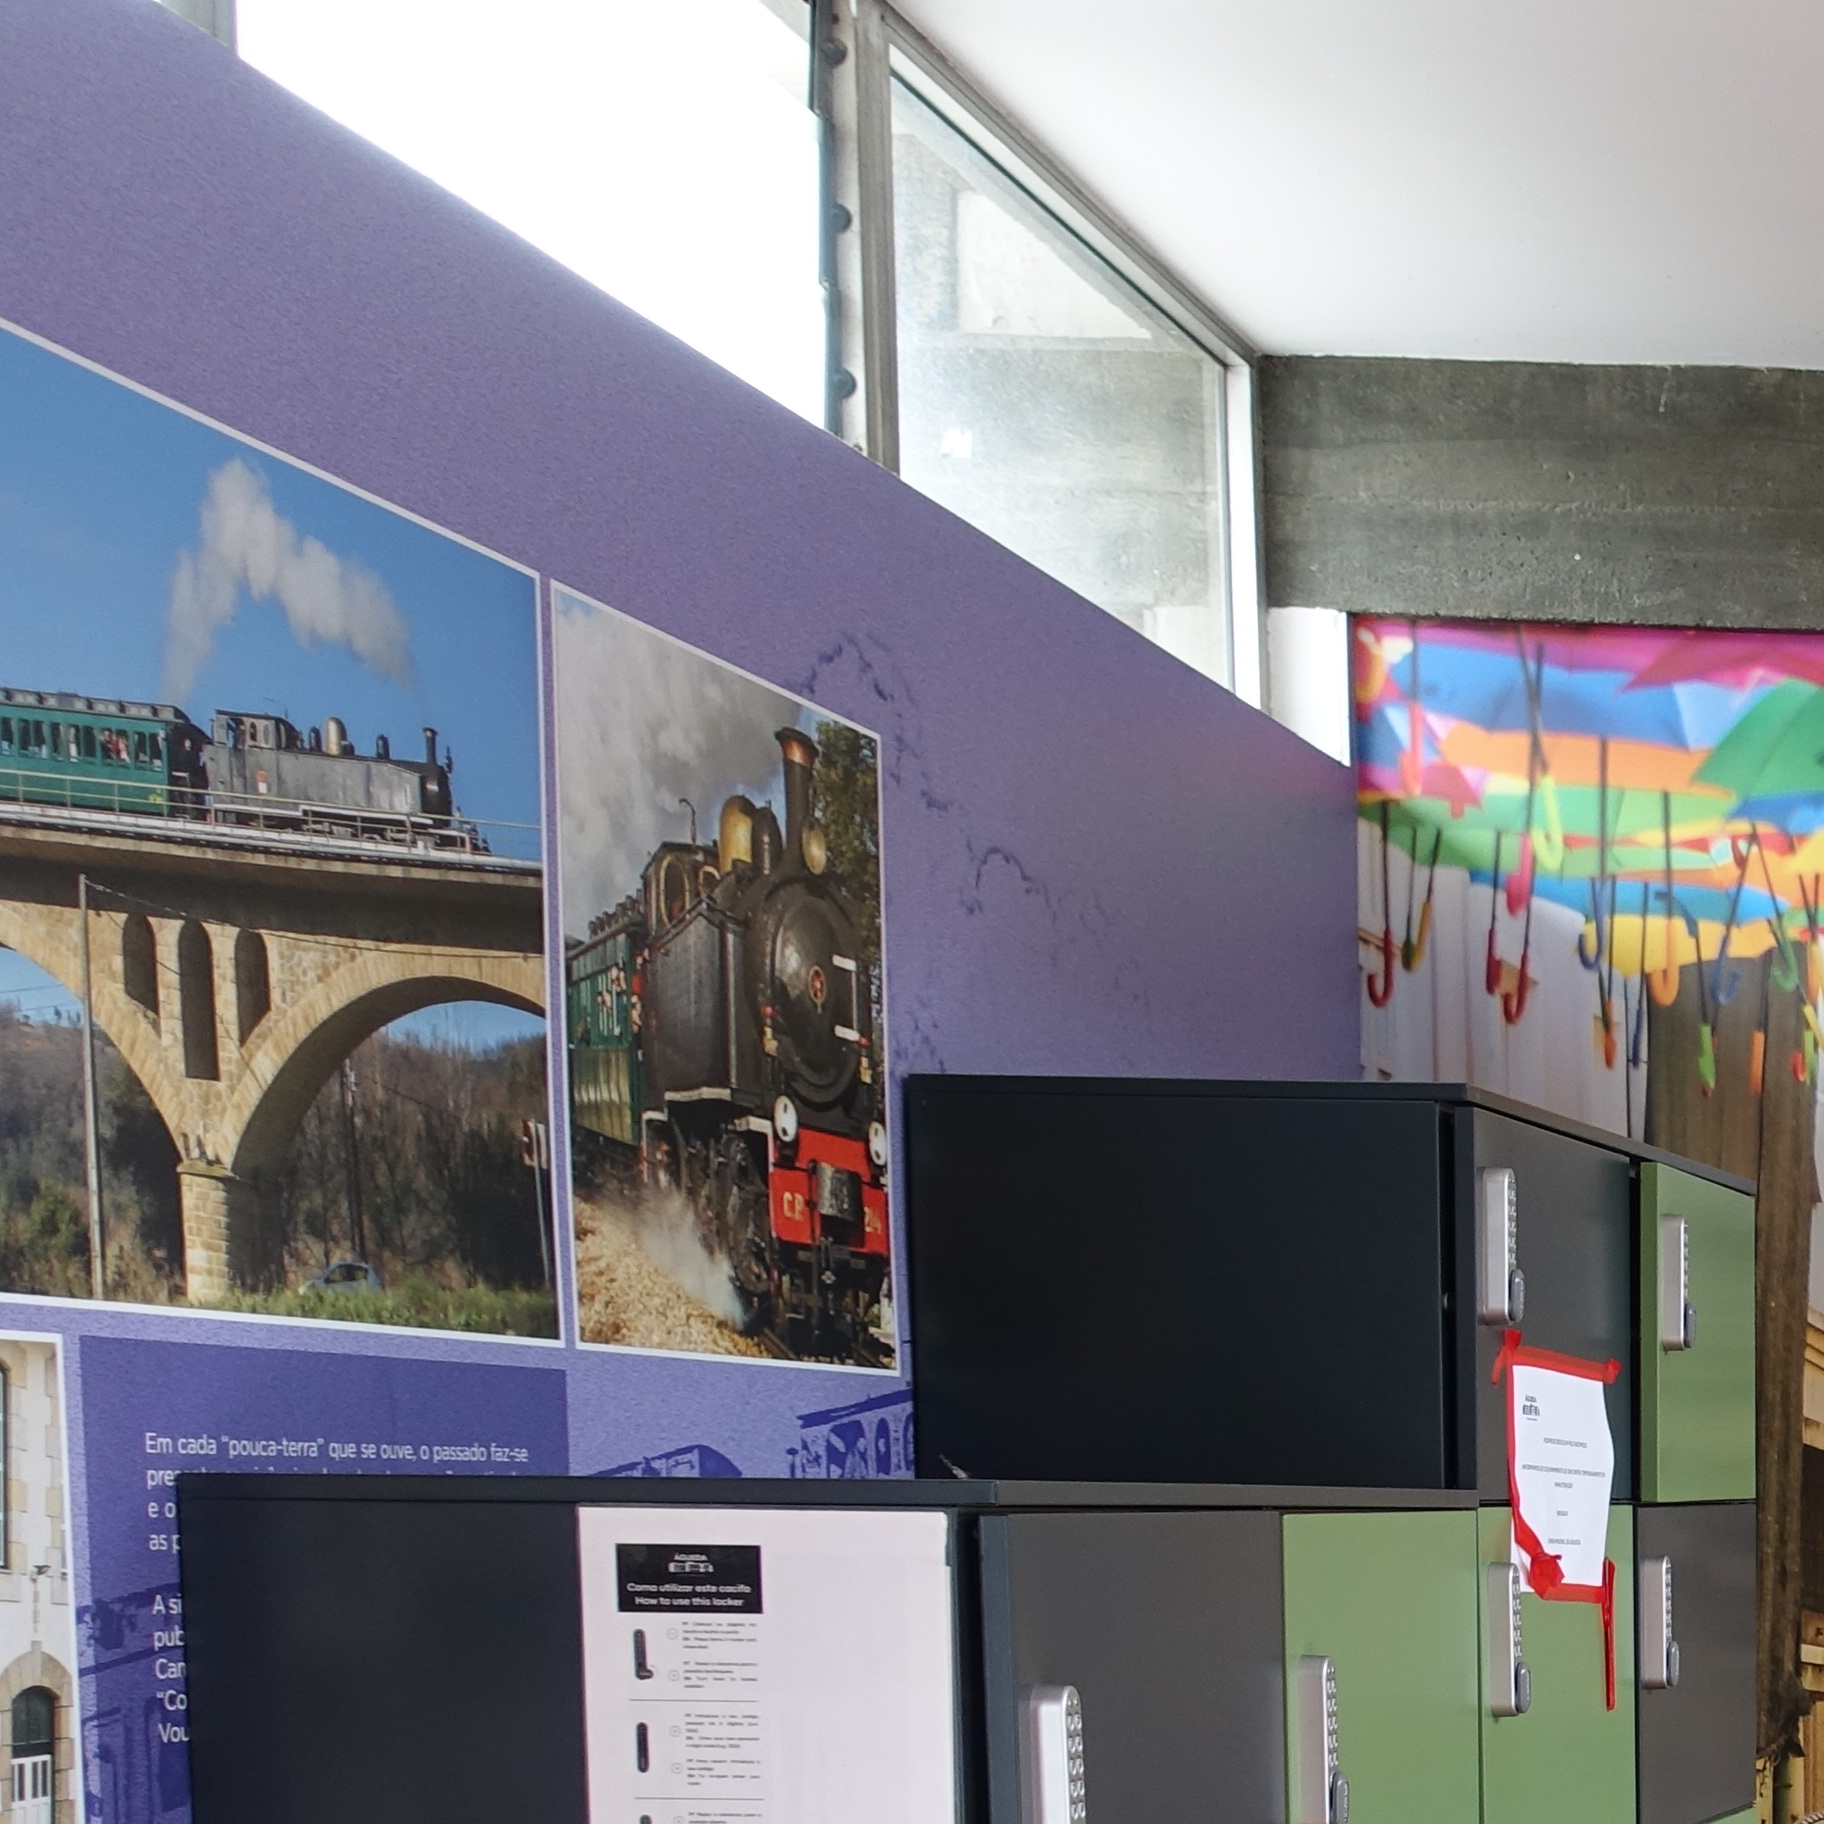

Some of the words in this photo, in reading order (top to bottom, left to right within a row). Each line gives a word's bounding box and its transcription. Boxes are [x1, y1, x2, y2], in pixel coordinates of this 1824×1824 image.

[145, 1432, 173, 1454] Em
[177, 1433, 217, 1455] cada
[328, 1441, 358, 1461] que
[360, 1443, 377, 1459] se
[380, 1443, 417, 1462] ouve,
[420, 1446, 430, 1461] o
[433, 1442, 487, 1464] passado
[490, 1443, 529, 1463] faz-se
[148, 1502, 159, 1518] e
[149, 1534, 168, 1551] as
[152, 1594, 166, 1615] A
